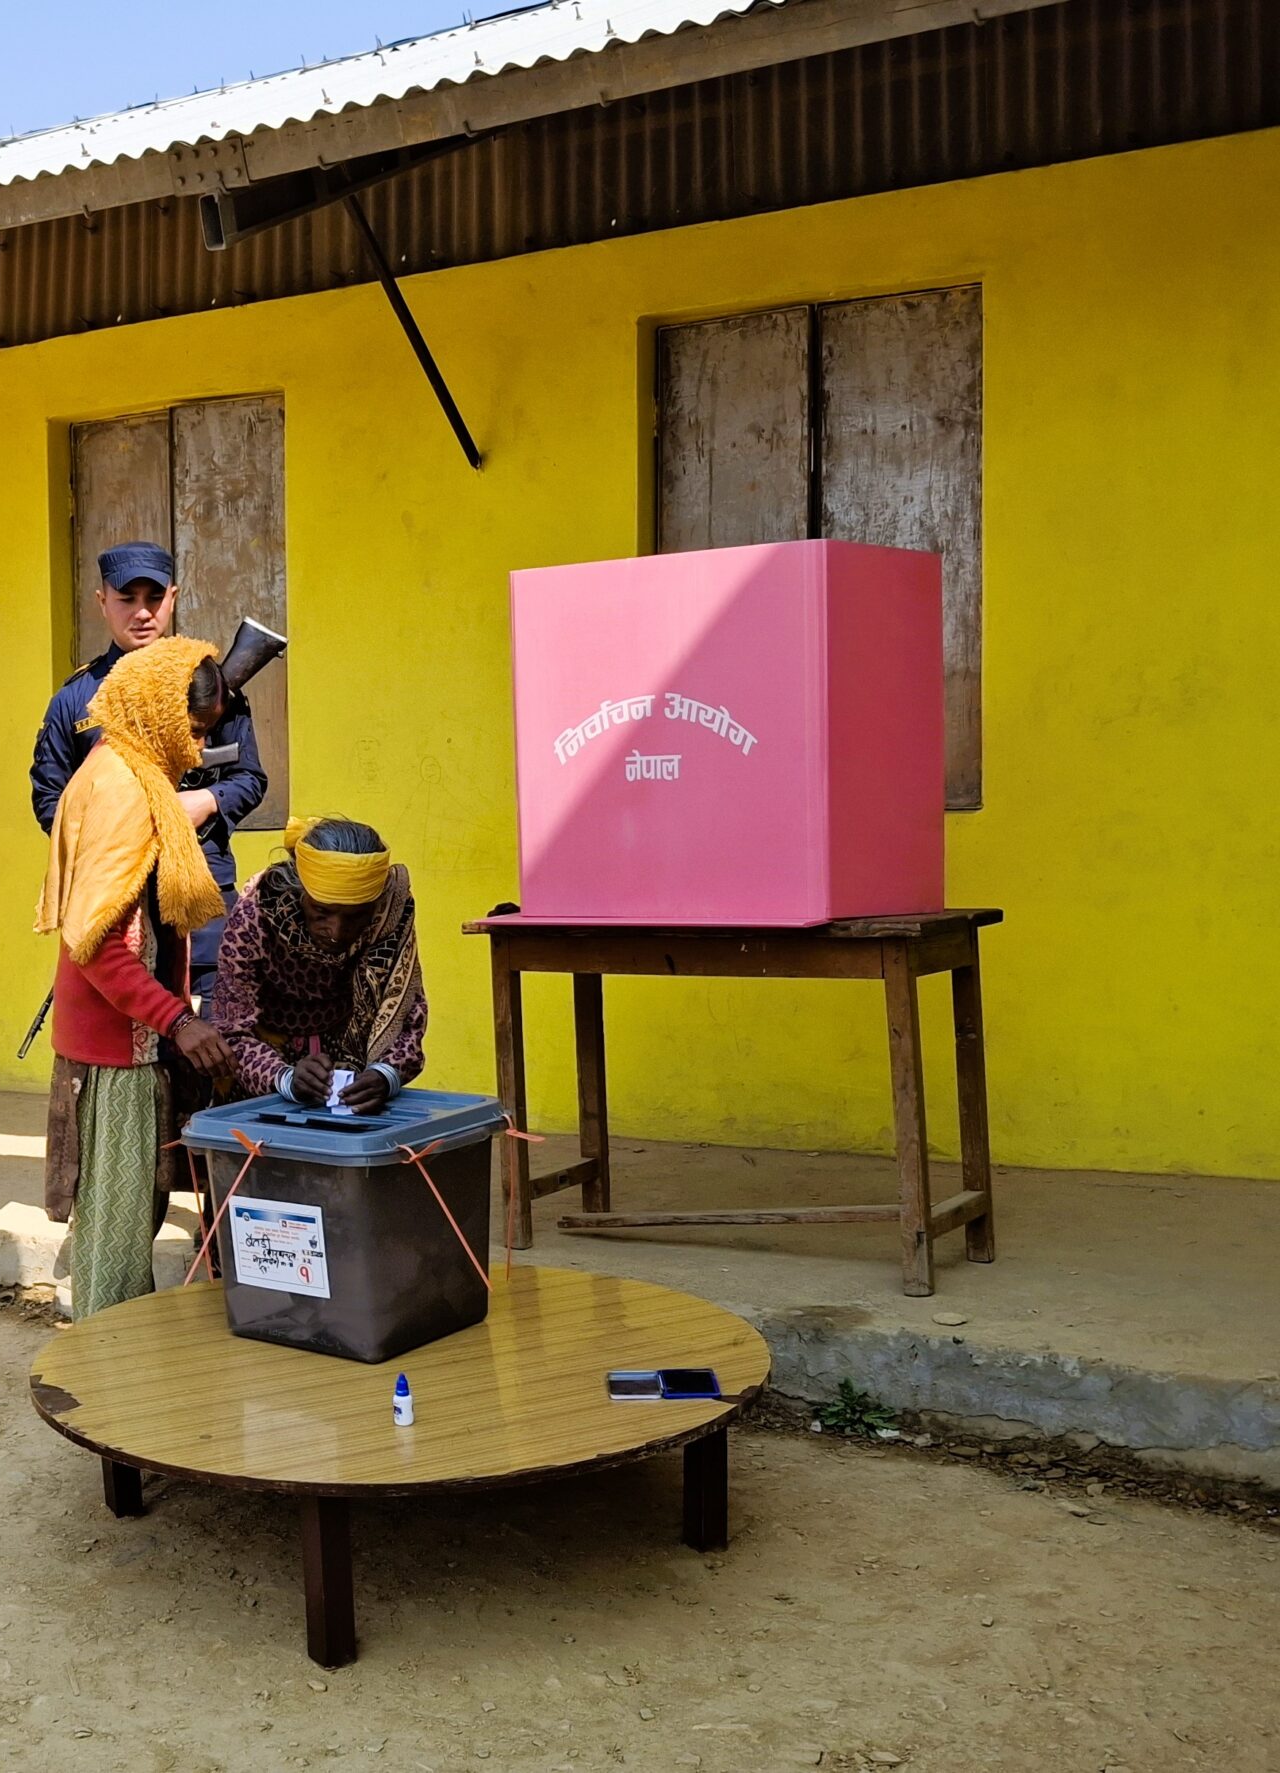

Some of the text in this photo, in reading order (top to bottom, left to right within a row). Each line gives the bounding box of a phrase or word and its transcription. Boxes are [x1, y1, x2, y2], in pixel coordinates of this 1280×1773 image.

[553, 692, 758, 765] निर्वाचन आयोग
[624, 750, 682, 782] नेपाल
